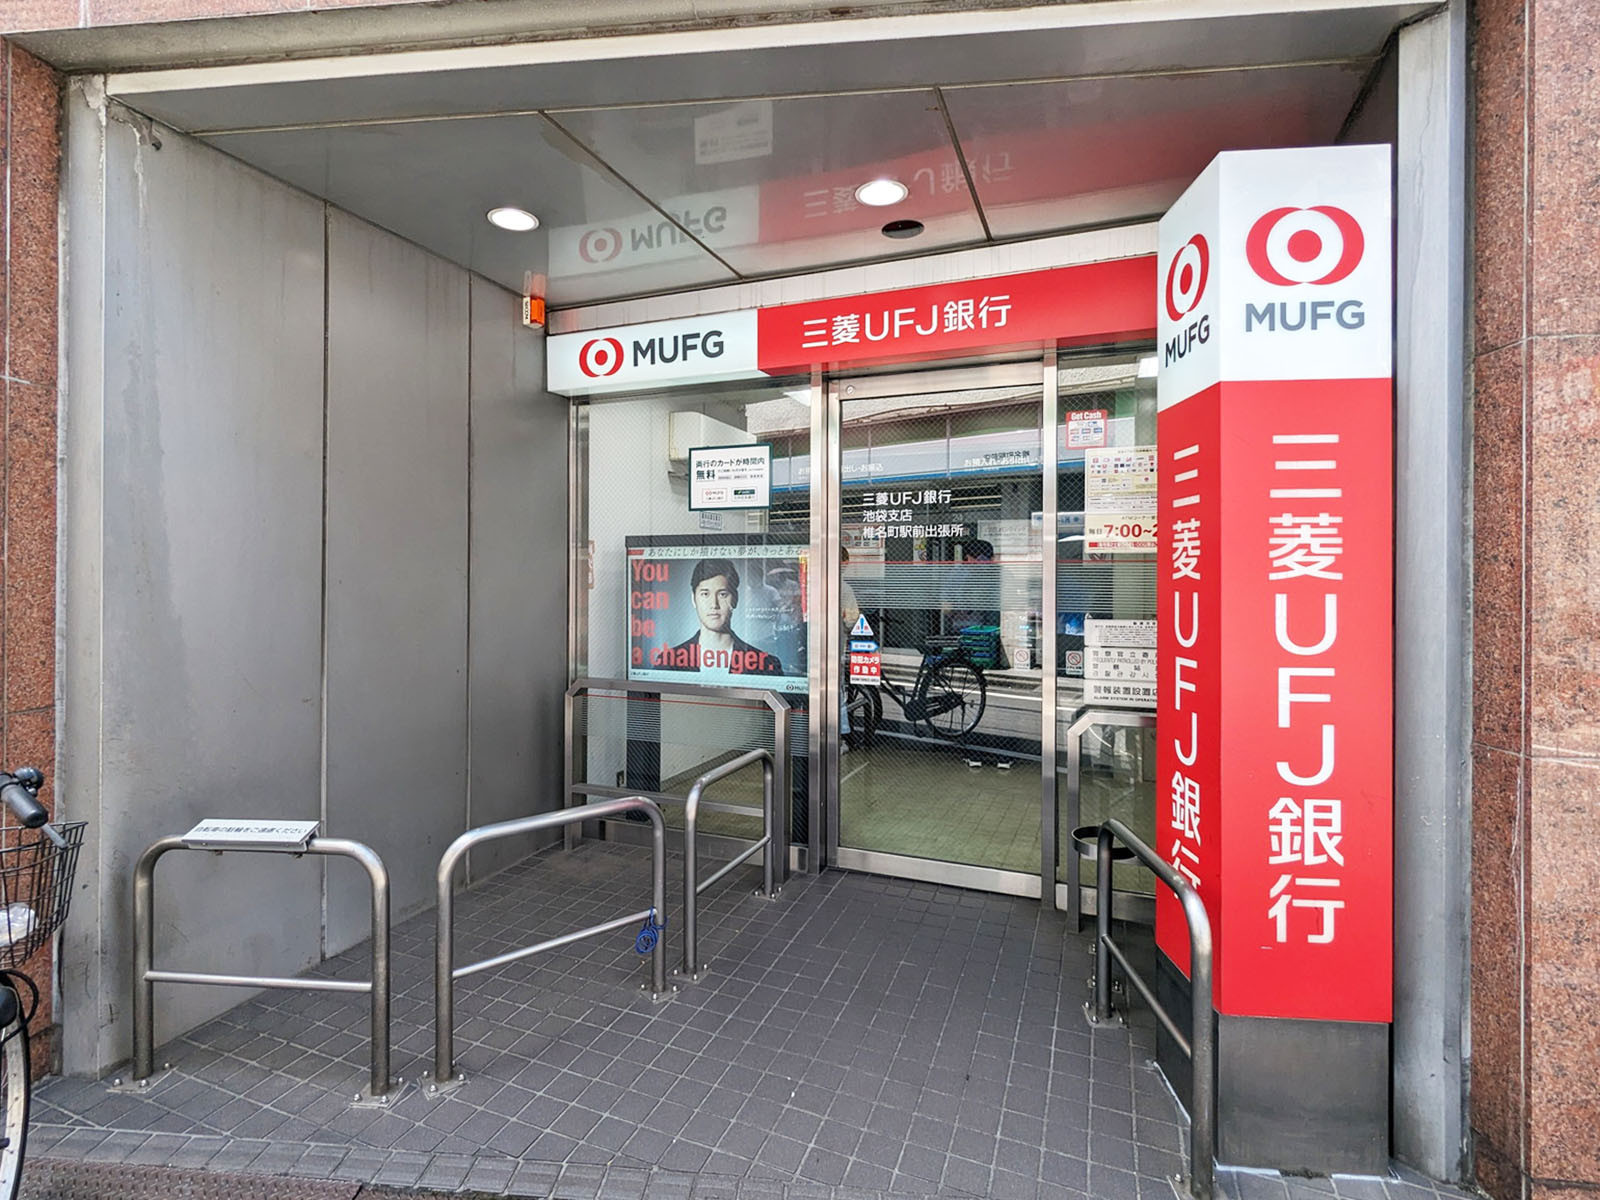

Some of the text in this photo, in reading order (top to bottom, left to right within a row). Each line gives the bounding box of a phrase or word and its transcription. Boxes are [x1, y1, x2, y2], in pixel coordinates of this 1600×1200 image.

[802, 295, 1012, 348] 三菱UFJ銀行
[1246, 300, 1365, 332] MUFG
[633, 330, 724, 367] MUFG
[1165, 315, 1210, 368] MUFG
[1071, 411, 1102, 420] Get Cash
[696, 470, 715, 480] 無料
[863, 489, 951, 506] 三菱UFJ銀行
[862, 509, 913, 522] 池袋支店
[863, 523, 964, 538] 椎名町駅前出張所
[632, 559, 669, 582] You
[631, 590, 669, 609] can
[632, 614, 656, 637] be
[632, 643, 775, 674] a challenger.
[1092, 650, 1157, 659] 警察官立寄
[1268, 434, 1345, 944] 三菱UFJ銀行
